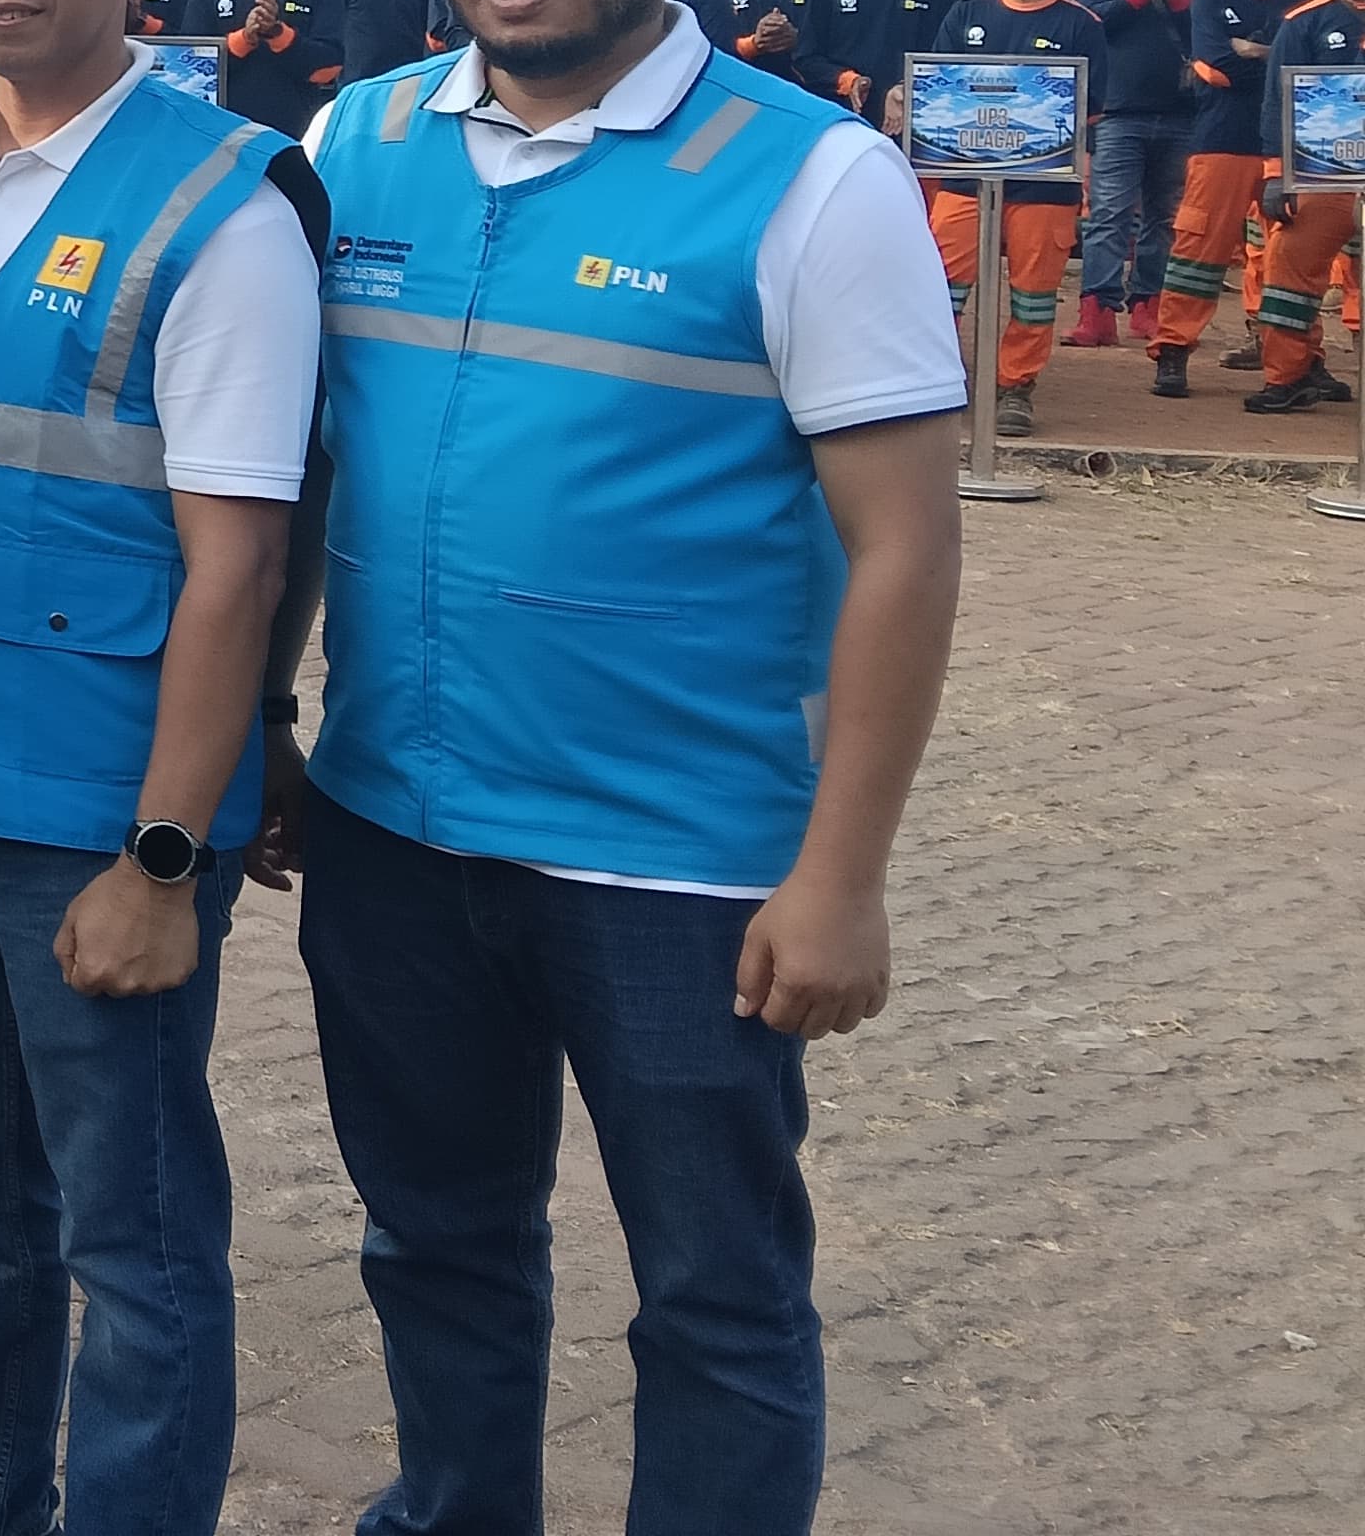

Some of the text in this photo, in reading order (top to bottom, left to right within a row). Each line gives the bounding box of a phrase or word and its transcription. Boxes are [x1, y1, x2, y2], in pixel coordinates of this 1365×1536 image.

[977, 107, 1008, 126] UP3
[612, 265, 668, 294] PLN
[27, 288, 84, 320] PLN
